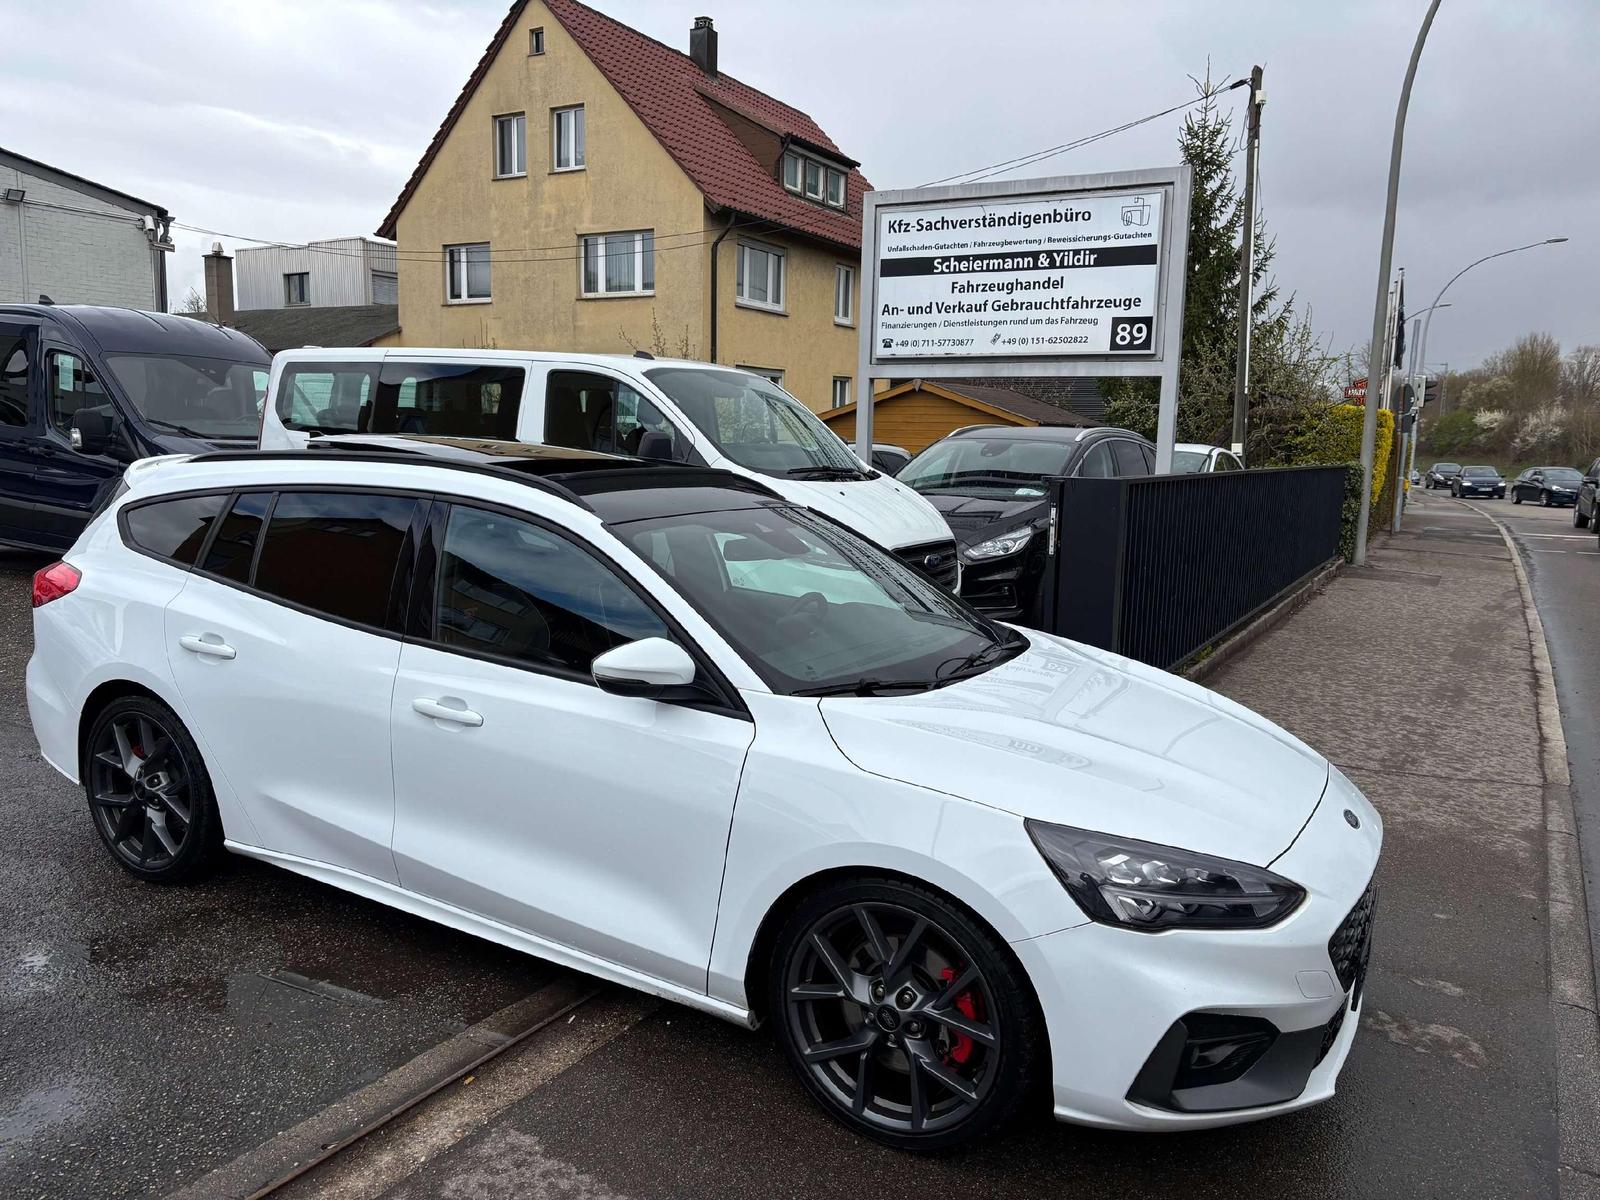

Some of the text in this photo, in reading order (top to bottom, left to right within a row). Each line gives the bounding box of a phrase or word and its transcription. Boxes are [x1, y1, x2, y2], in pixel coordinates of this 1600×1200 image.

[888, 208, 1092, 234] Kfz-Sachverständigenbüro
[887, 241, 969, 252] Unfallschaden-Gutachten
[973, 237, 1042, 248] Fahrzeugbewertung
[1047, 231, 1152, 244] Beweissicherungs-Gutachten
[933, 250, 1097, 273] Scheiermann & Yildir
[951, 276, 1064, 295] Fahrzeughandel
[881, 295, 1142, 316] An- und Verkauf Gebrauchtfahrzeuge
[881, 321, 937, 330] Finanzierungen
[943, 319, 1008, 328] Dienstleistungen
[1009, 317, 1029, 325] rund
[1045, 316, 1059, 325] das
[1060, 316, 1098, 326] Fahrzeug
[895, 338, 974, 348] +49 (0) 711-57730877
[1001, 335, 1089, 346] +49 (0) 151-62502822
[1115, 323, 1148, 345] 89
